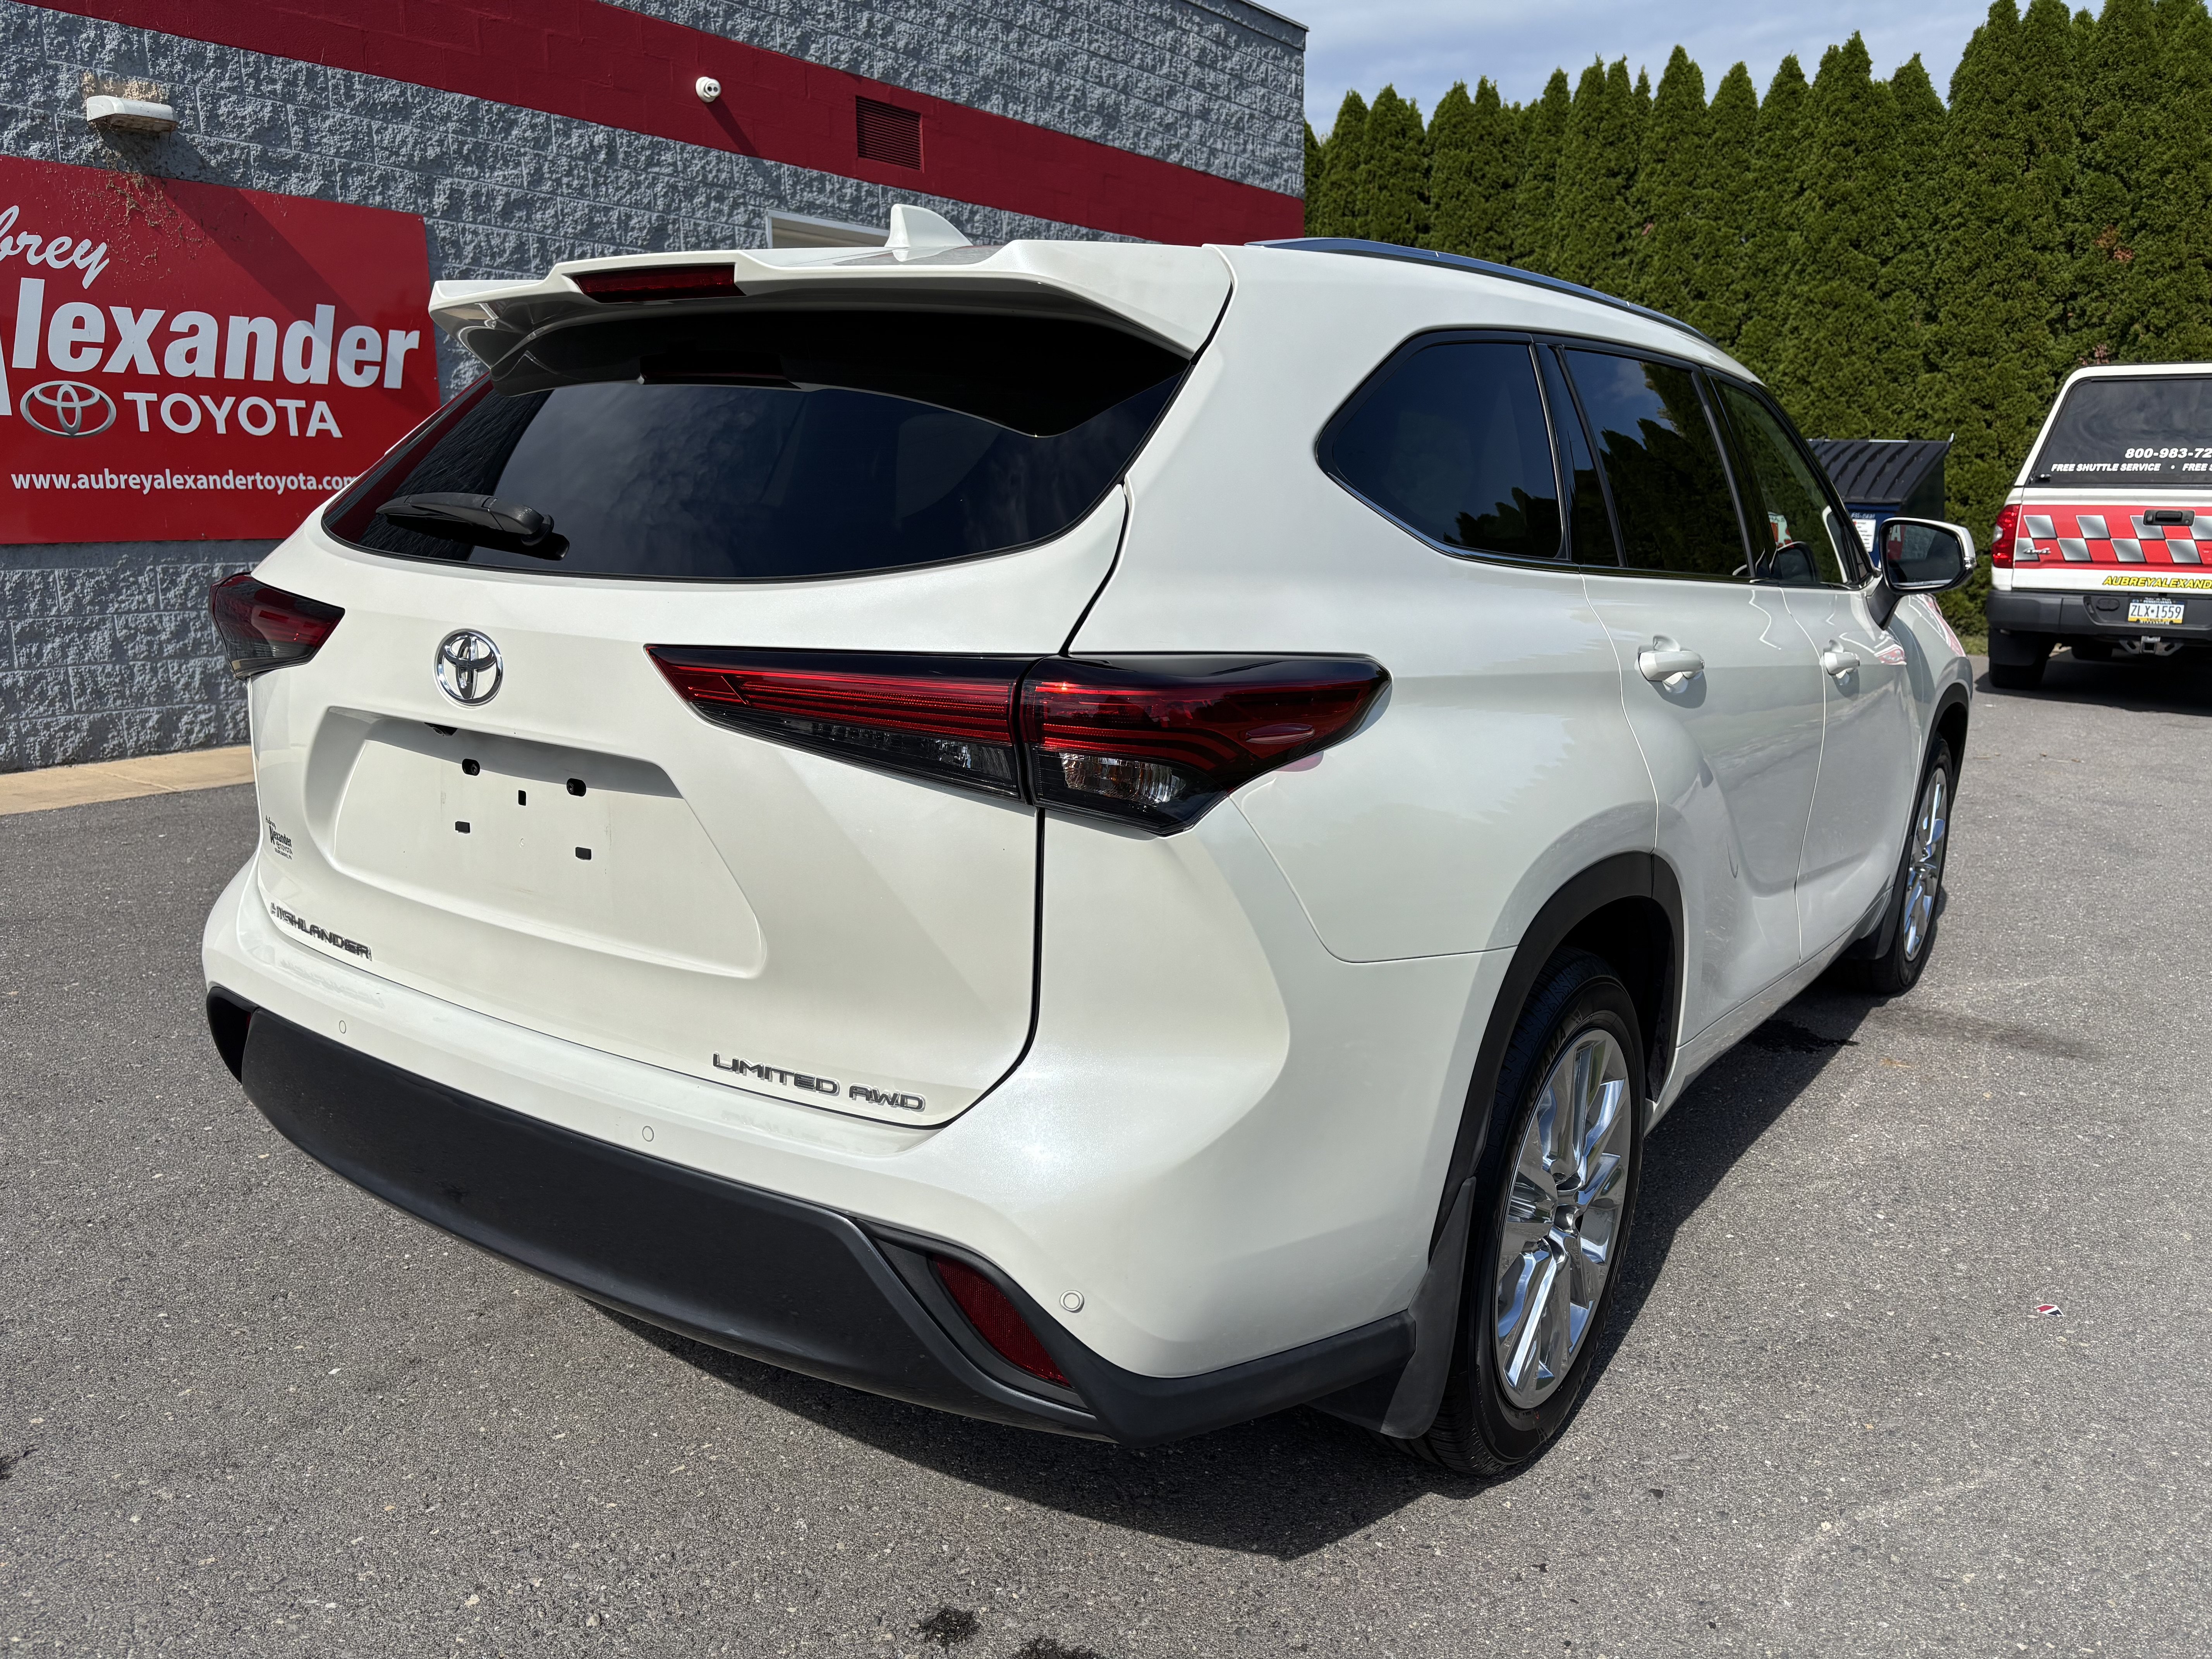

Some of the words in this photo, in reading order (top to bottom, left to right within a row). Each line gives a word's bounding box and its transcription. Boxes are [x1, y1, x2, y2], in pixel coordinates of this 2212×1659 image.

[124, 392, 343, 438] TOYOTA
[2125, 448, 2212, 459] 800-983-72
[2051, 464, 2075, 472] FREE
[2076, 463, 2119, 472] SHUTTLE
[2120, 463, 2161, 471] SERVICE
[2182, 463, 2208, 471] FREE
[2102, 576, 2212, 589] AUBREYALEXAND
[713, 1051, 840, 1096] LIMITED
[849, 1083, 926, 1112] AWD
